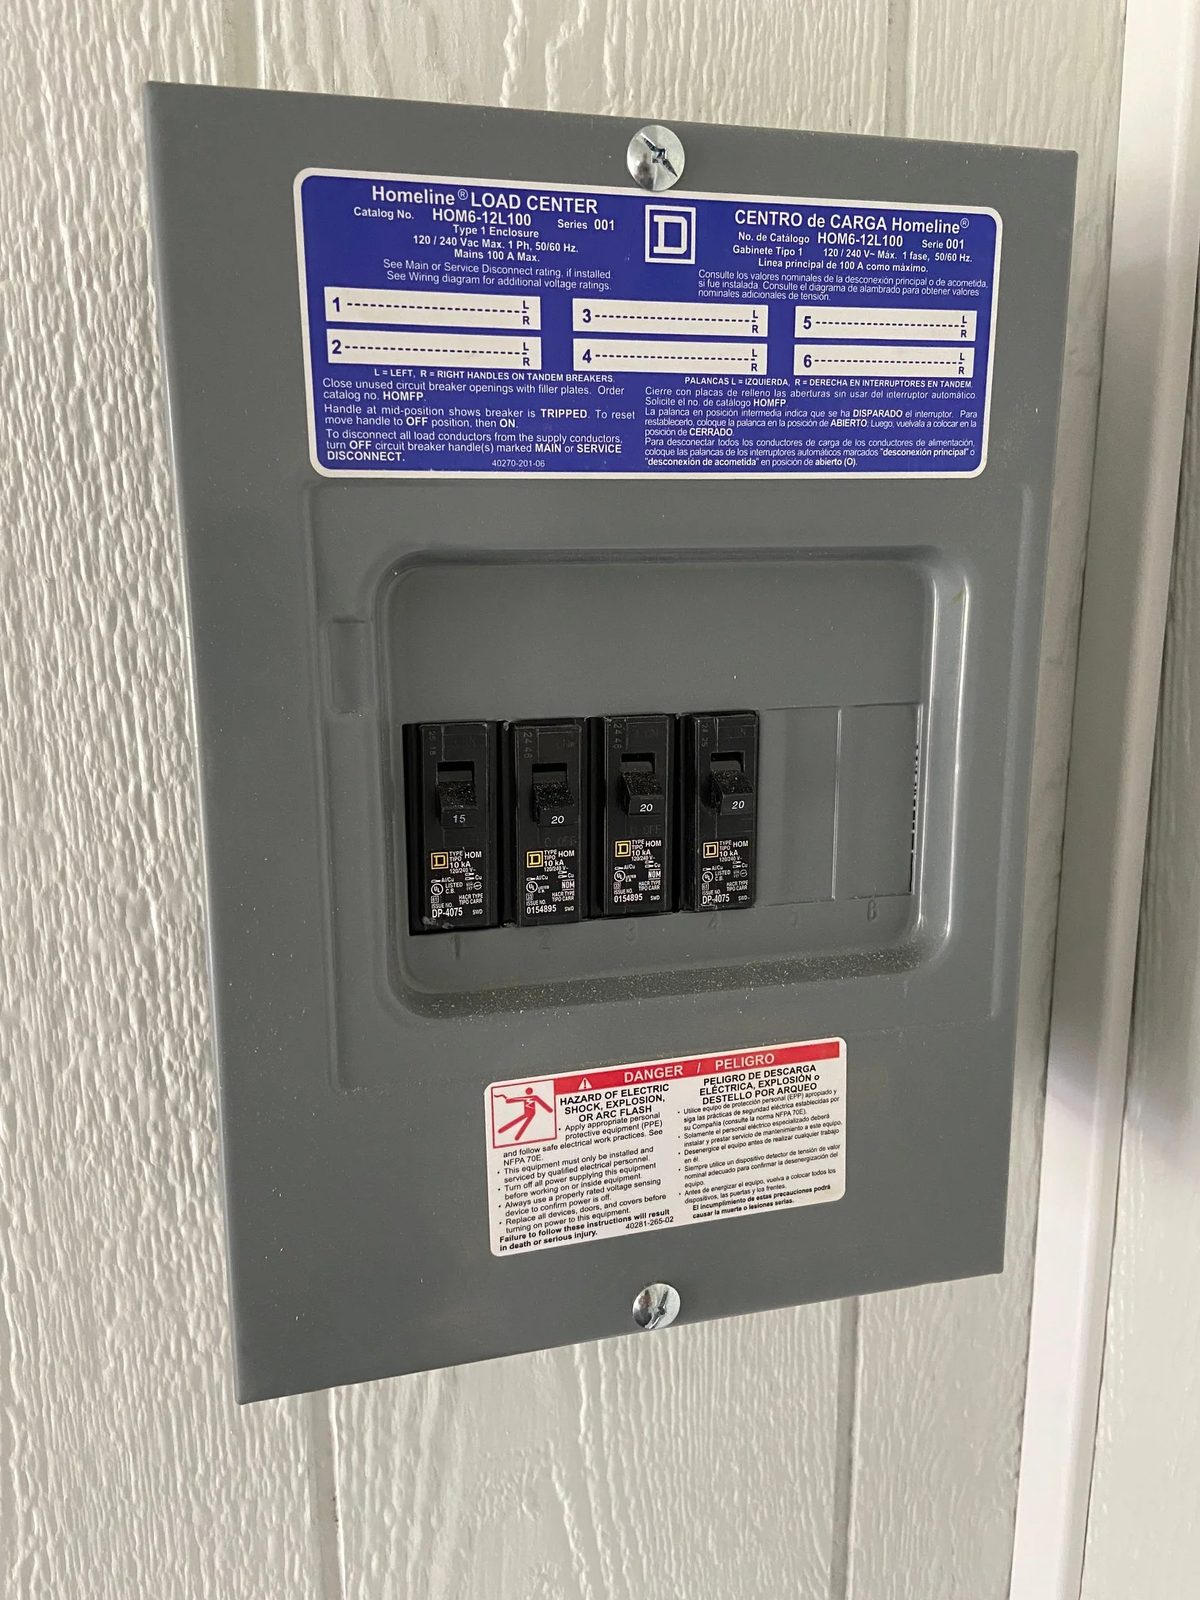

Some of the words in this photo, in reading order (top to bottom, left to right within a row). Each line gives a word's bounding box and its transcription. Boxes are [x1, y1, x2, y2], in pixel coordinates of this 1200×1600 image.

[470, 191, 521, 209] LOAD
[526, 194, 598, 214] CENTER
[353, 206, 394, 220] Catalog
[396, 208, 414, 219] No.
[432, 208, 531, 226] HOM6-12L100
[734, 209, 803, 227] CENTRO
[807, 212, 826, 228] de
[829, 213, 887, 231] CARGA
[452, 223, 478, 236] Type
[480, 225, 485, 235] 1
[488, 225, 539, 238] Enclosure
[557, 218, 588, 230] Series
[593, 218, 614, 231] 001
[413, 234, 431, 245] 120
[439, 235, 458, 246] 240
[459, 236, 479, 248] Vac
[481, 238, 505, 249] Max.
[508, 239, 513, 249] 1
[516, 240, 532, 251] Ph,
[535, 241, 561, 252] 50/60
[563, 242, 579, 253] Hz.
[738, 231, 754, 241] No.
[755, 232, 768, 242] de
[769, 232, 810, 245] Catálogo
[817, 231, 903, 247] HOM6-12L100
[921, 239, 944, 249] Serie
[945, 237, 964, 250] 001
[454, 248, 484, 259] Mains
[487, 250, 504, 260] 100
[506, 251, 515, 261] A
[516, 251, 540, 262] Max.
[732, 244, 773, 255] Gabinete
[775, 246, 796, 257] Tipo
[797, 247, 802, 256] 1
[823, 247, 839, 257] 120
[845, 248, 862, 258] 240
[877, 249, 897, 259] Máx.
[902, 250, 907, 260] 1
[909, 250, 930, 262] fase,
[934, 251, 957, 262] 50/60
[958, 253, 973, 262] Hz.
[383, 258, 403, 269] See
[405, 259, 429, 270] Main
[431, 263, 441, 271] or
[443, 261, 479, 273] Service
[481, 263, 533, 276] Disconnect
[535, 267, 564, 279] rating,
[566, 267, 572, 277] if
[784, 259, 824, 271] principal
[825, 260, 837, 269] de
[839, 260, 855, 270] 100
[856, 261, 864, 270] A
[865, 263, 890, 271] como
[891, 262, 928, 273] máximo.
[332, 296, 340, 312] 1
[582, 308, 592, 323] 3
[802, 315, 812, 330] 5
[331, 338, 342, 355] 2
[581, 348, 592, 364] 4
[803, 354, 812, 368] 6
[322, 377, 353, 389] Close
[355, 379, 393, 390] unused
[395, 381, 426, 392] circuit
[428, 380, 467, 392] breaker
[468, 382, 514, 395] openings
[515, 383, 536, 394] with
[537, 383, 559, 394] filler
[560, 384, 592, 396] plates.
[597, 384, 625, 395] Order
[323, 389, 361, 402] catalog
[645, 395, 676, 406] Solicite
[677, 397, 686, 406] el
[702, 397, 714, 407] de
[715, 397, 751, 408] catálogo
[644, 427, 676, 437] posición
[676, 427, 688, 436] de
[326, 450, 405, 462] DISCONNECT.
[639, 803, 654, 813] 20
[731, 801, 745, 810] 20
[452, 814, 466, 824] 15
[551, 815, 565, 825] 20
[732, 840, 749, 848] HOM
[464, 850, 482, 859] HOM
[450, 861, 459, 869] 10
[613, 893, 643, 903] 0154895
[702, 894, 730, 904] DP-4075
[431, 907, 463, 919] DP-4075
[526, 904, 557, 914] 0154895
[715, 1052, 775, 1071] PELIGRO
[623, 1064, 683, 1083] DANGER
[703, 1073, 746, 1086] PELIGRO
[747, 1070, 761, 1081] DE
[763, 1064, 817, 1078] DESCARGA
[699, 1081, 756, 1096] ELÉCTRICA,
[757, 1073, 812, 1089] EXPLOSIÓN
[559, 1092, 602, 1106] HAZARD
[604, 1089, 618, 1100] OF
[620, 1083, 669, 1098] ELECTRIC
[702, 1090, 753, 1105] DESTELLO
[754, 1087, 775, 1098] POR
[776, 1082, 817, 1095] ARQUEO
[564, 1101, 603, 1115] SHOCK,
[605, 1093, 665, 1109] EXPLOSION,
[578, 1112, 594, 1123] OR
[595, 1109, 617, 1120] ARC
[619, 1104, 652, 1117] FLASH
[503, 1156, 526, 1167] NFPA
[526, 1153, 543, 1163] 70E.
[499, 1233, 527, 1243] Failure
[528, 1230, 537, 1238] to
[537, 1227, 562, 1237] follow
[563, 1223, 585, 1232] these
[586, 1215, 632, 1228] instructions
[633, 1211, 647, 1221] will
[648, 1208, 670, 1218] result
[624, 1215, 674, 1229] 40281-265-02
[499, 1244, 508, 1252] in
[508, 1239, 532, 1250] death
[532, 1238, 542, 1246] or
[543, 1233, 573, 1244] serious
[573, 1230, 598, 1240] injury.
